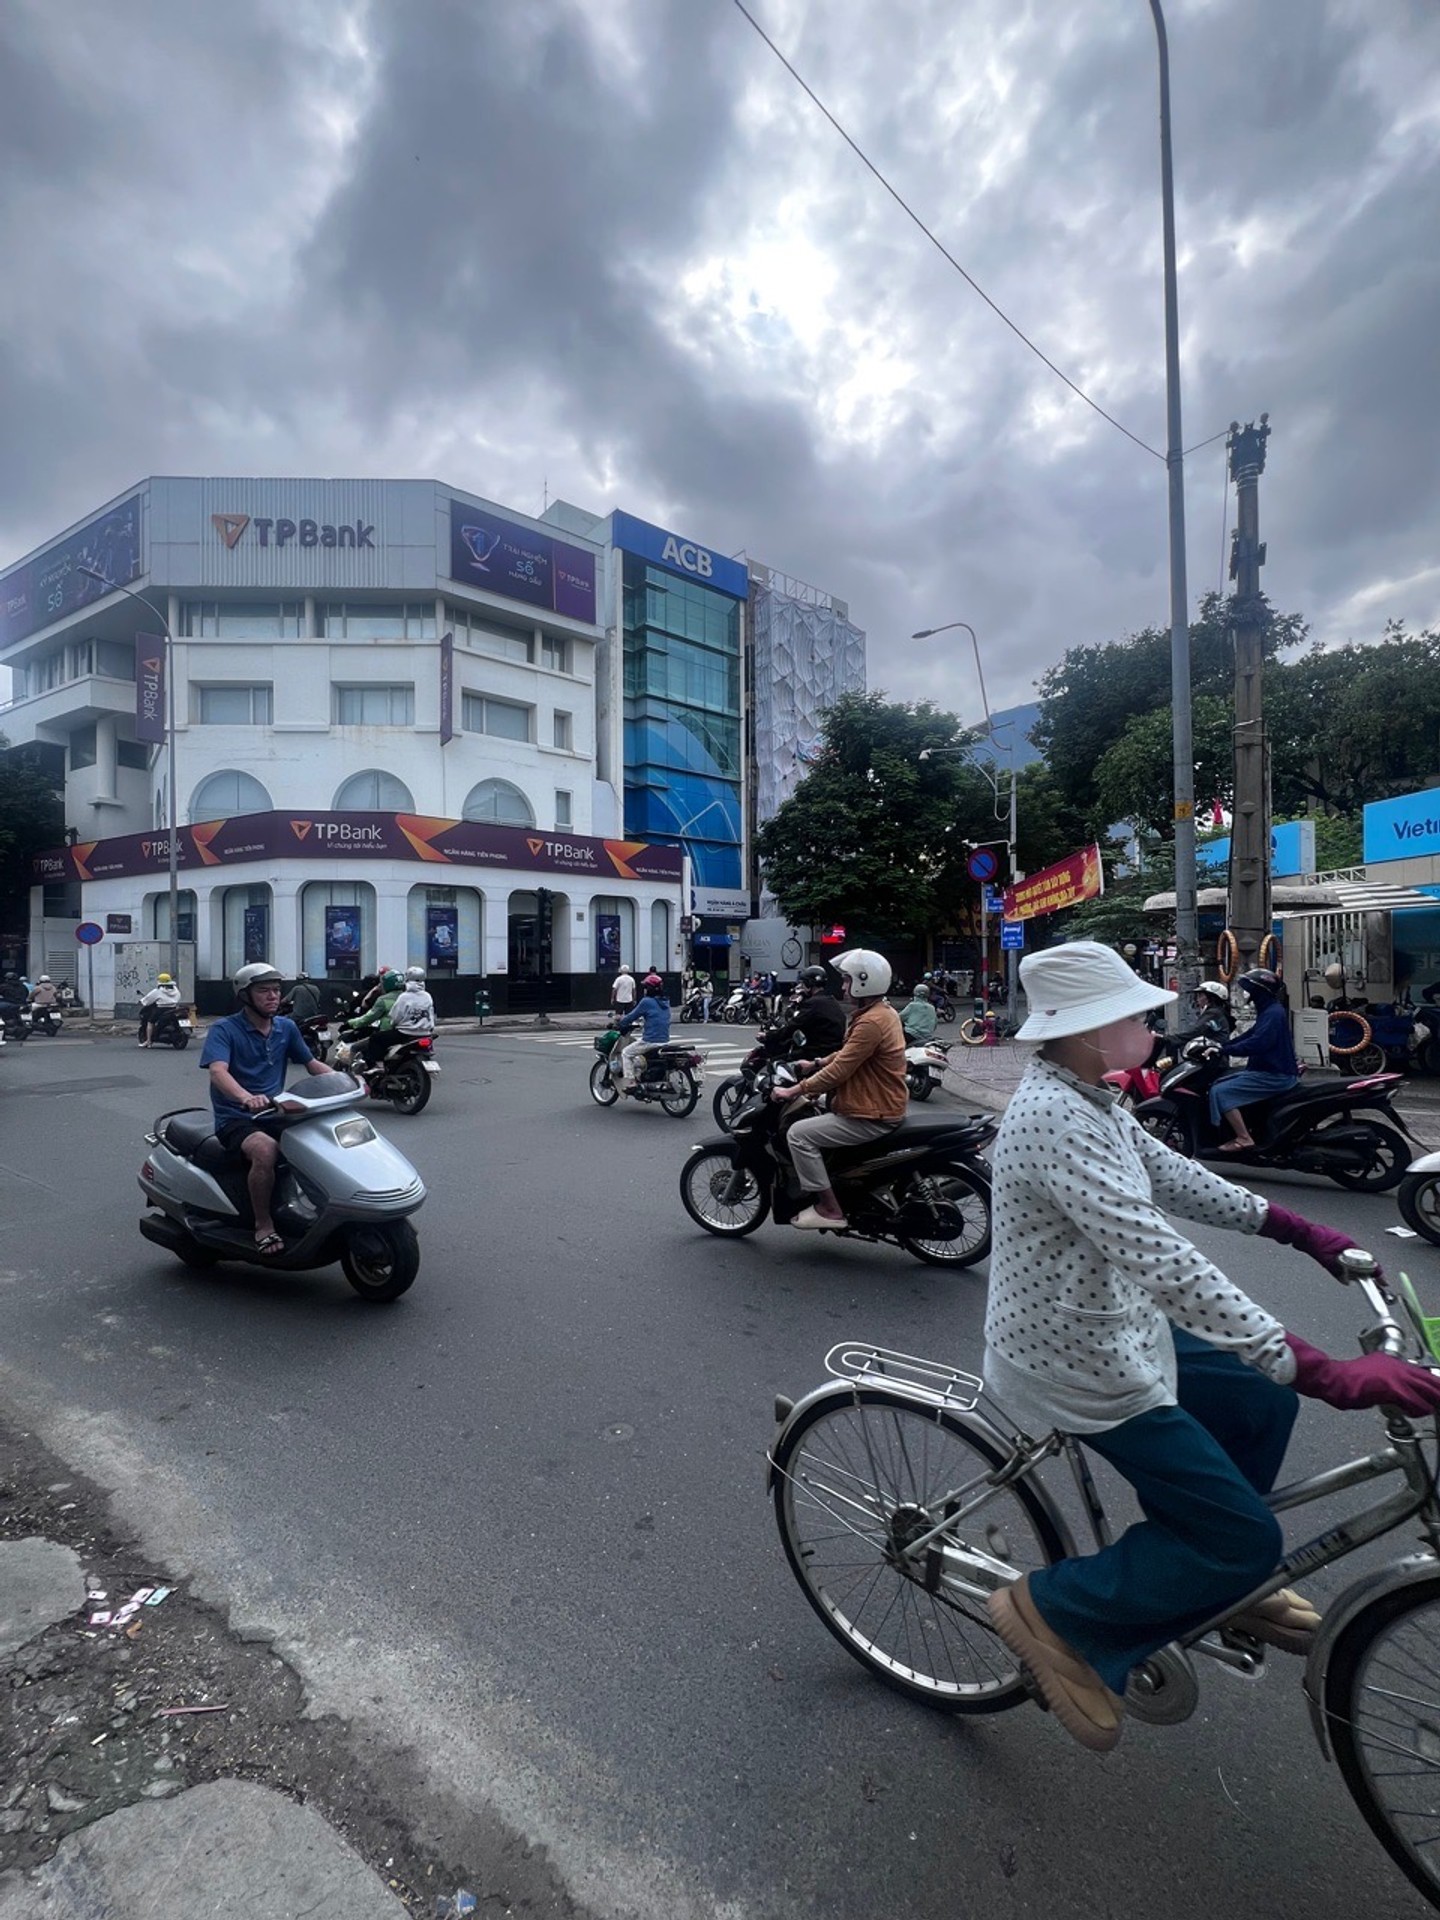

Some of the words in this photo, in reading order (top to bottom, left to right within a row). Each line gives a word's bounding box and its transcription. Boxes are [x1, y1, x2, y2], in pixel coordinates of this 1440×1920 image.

[255, 518, 375, 548] TPBank
[662, 536, 713, 578] ACB
[516, 560, 534, 576] SỐ
[143, 674, 159, 721] TPBank
[315, 823, 383, 840] TPBank
[1393, 818, 1440, 840] Vieti
[152, 838, 184, 856] TPBk
[545, 842, 594, 861] TPBank
[40, 858, 65, 872] TPBank
